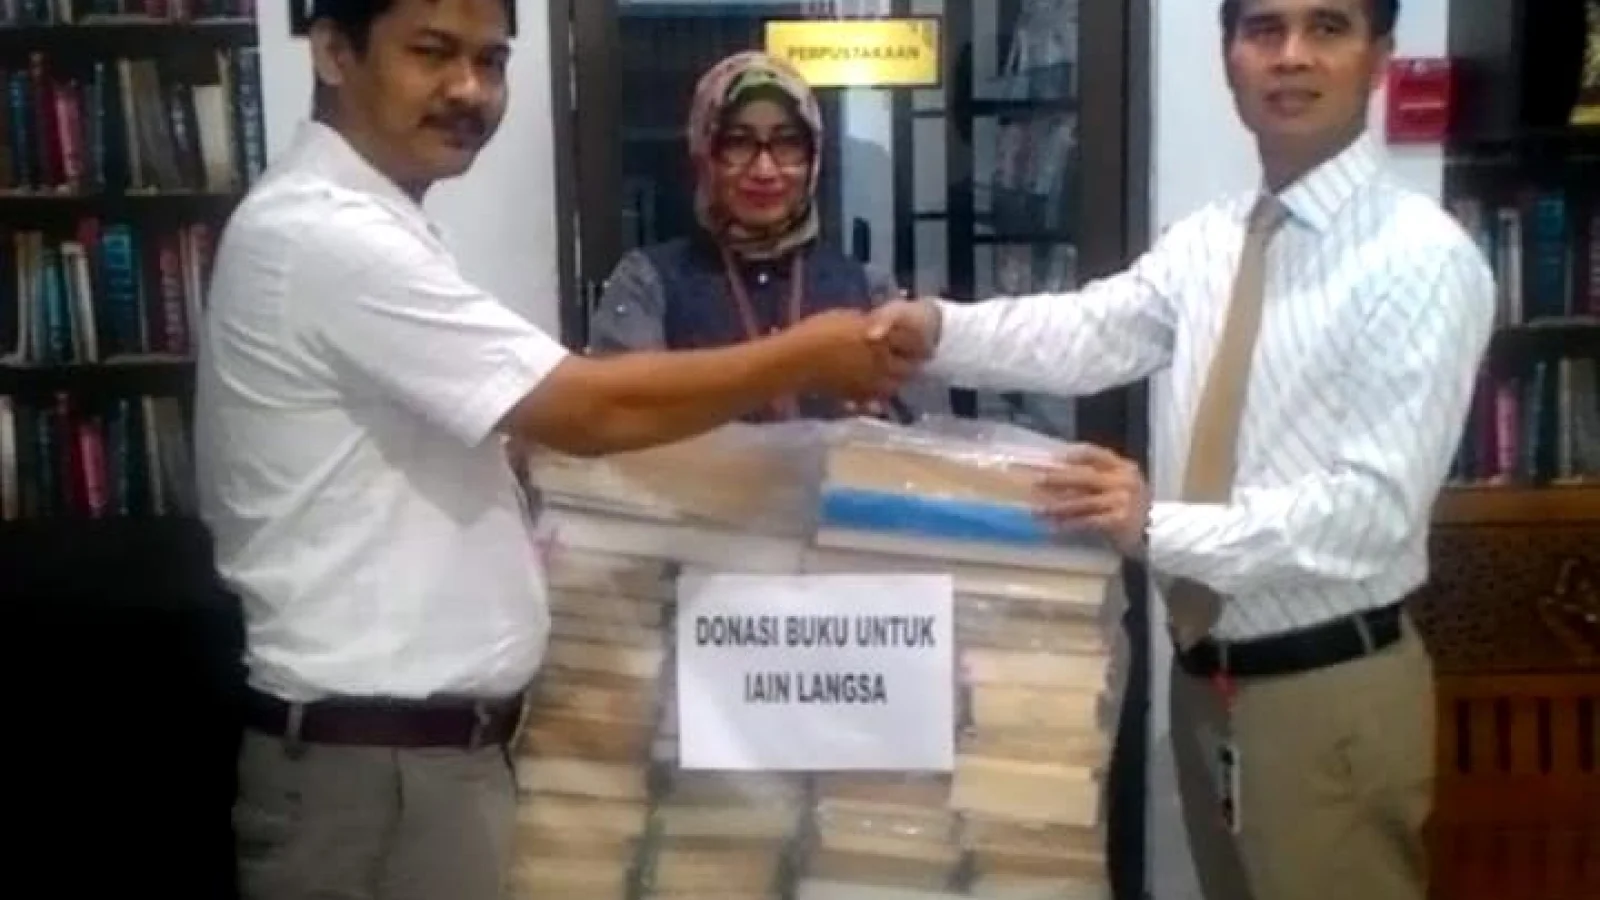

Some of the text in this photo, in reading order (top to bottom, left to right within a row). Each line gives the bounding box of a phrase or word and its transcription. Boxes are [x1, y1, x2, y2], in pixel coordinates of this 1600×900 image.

[696, 615, 936, 647] DONASI BUKU UNTUK
[745, 673, 888, 704] IAIN LANGSA
